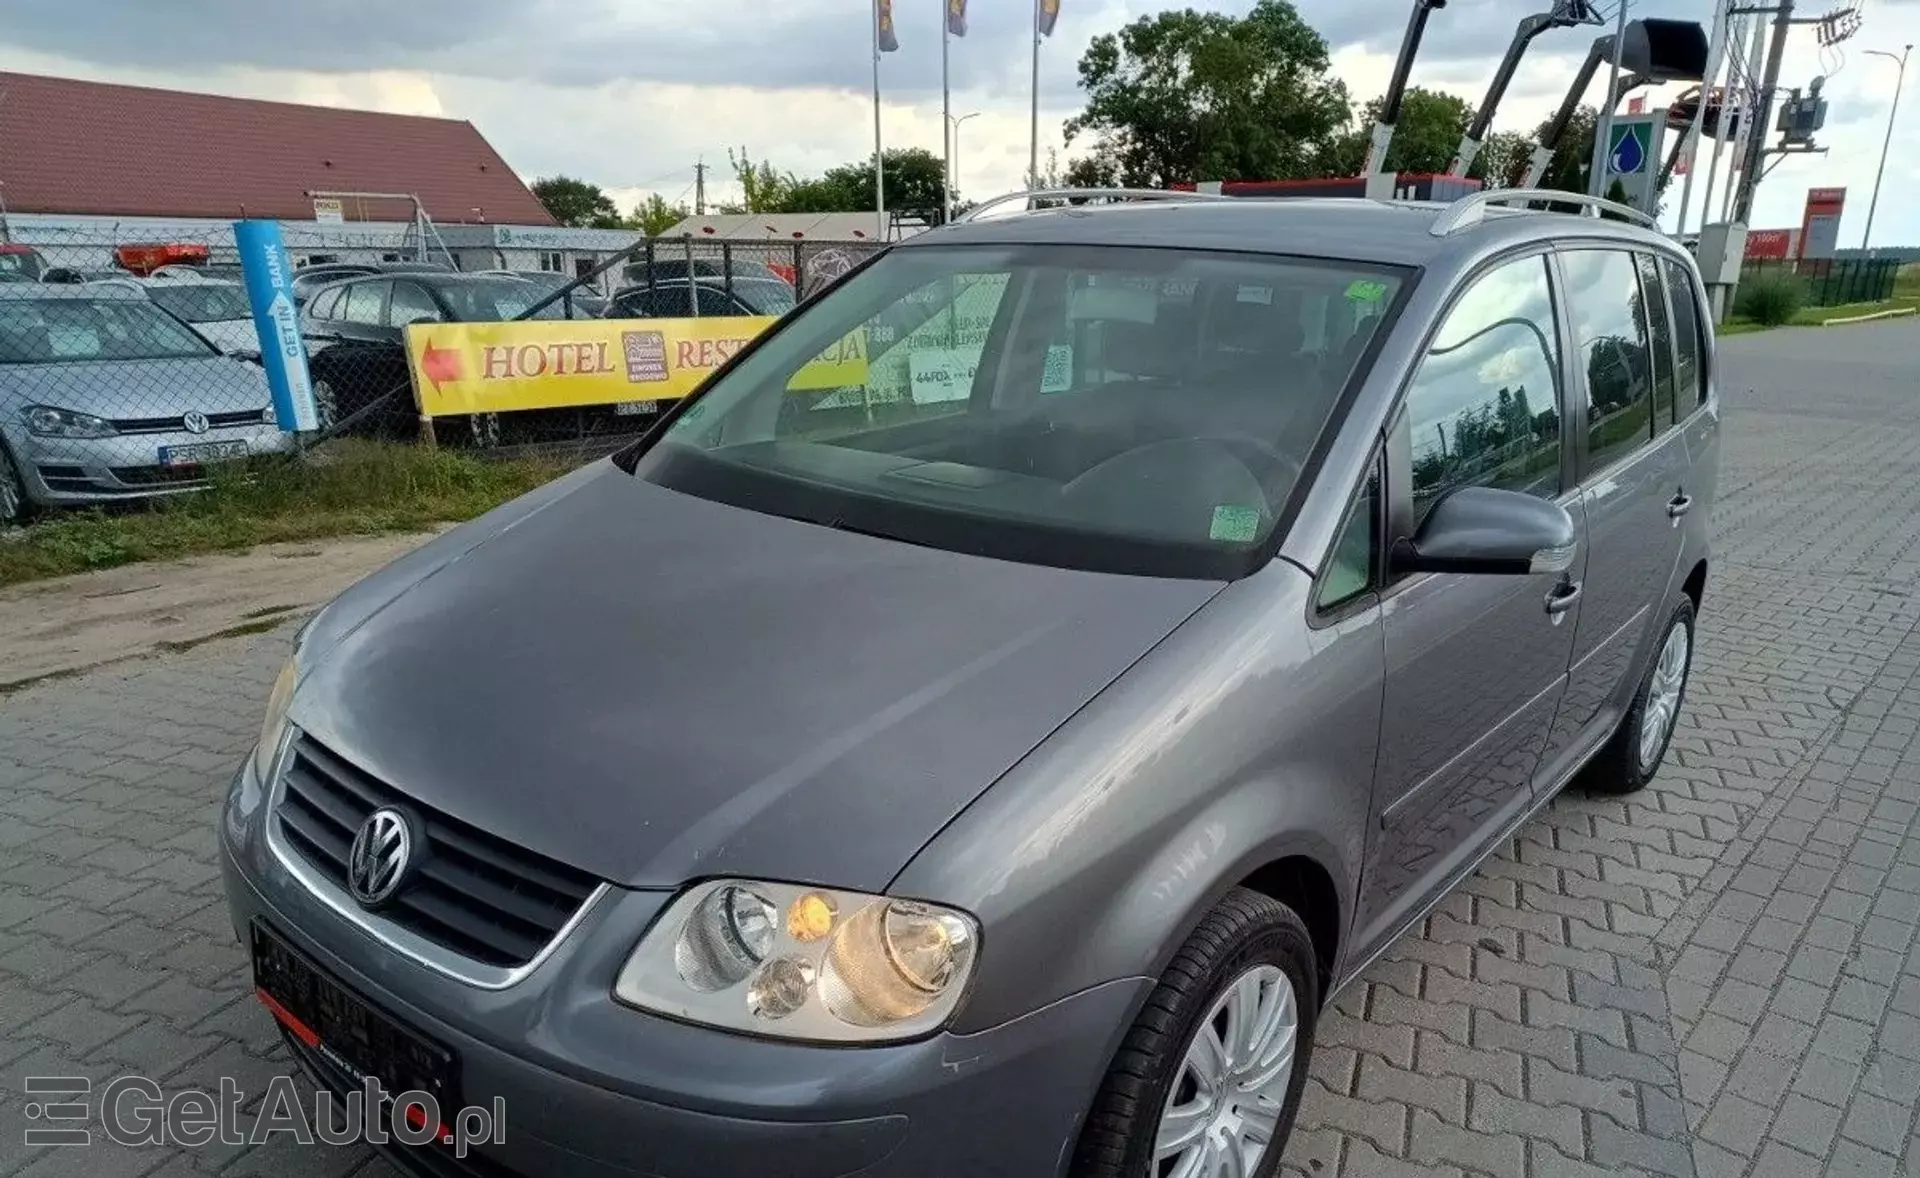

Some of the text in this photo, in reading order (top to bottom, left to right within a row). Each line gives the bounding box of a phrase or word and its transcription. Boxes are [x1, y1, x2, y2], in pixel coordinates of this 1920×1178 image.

[263, 243, 299, 357] GET IN BANK
[482, 341, 616, 379] HOTEL
